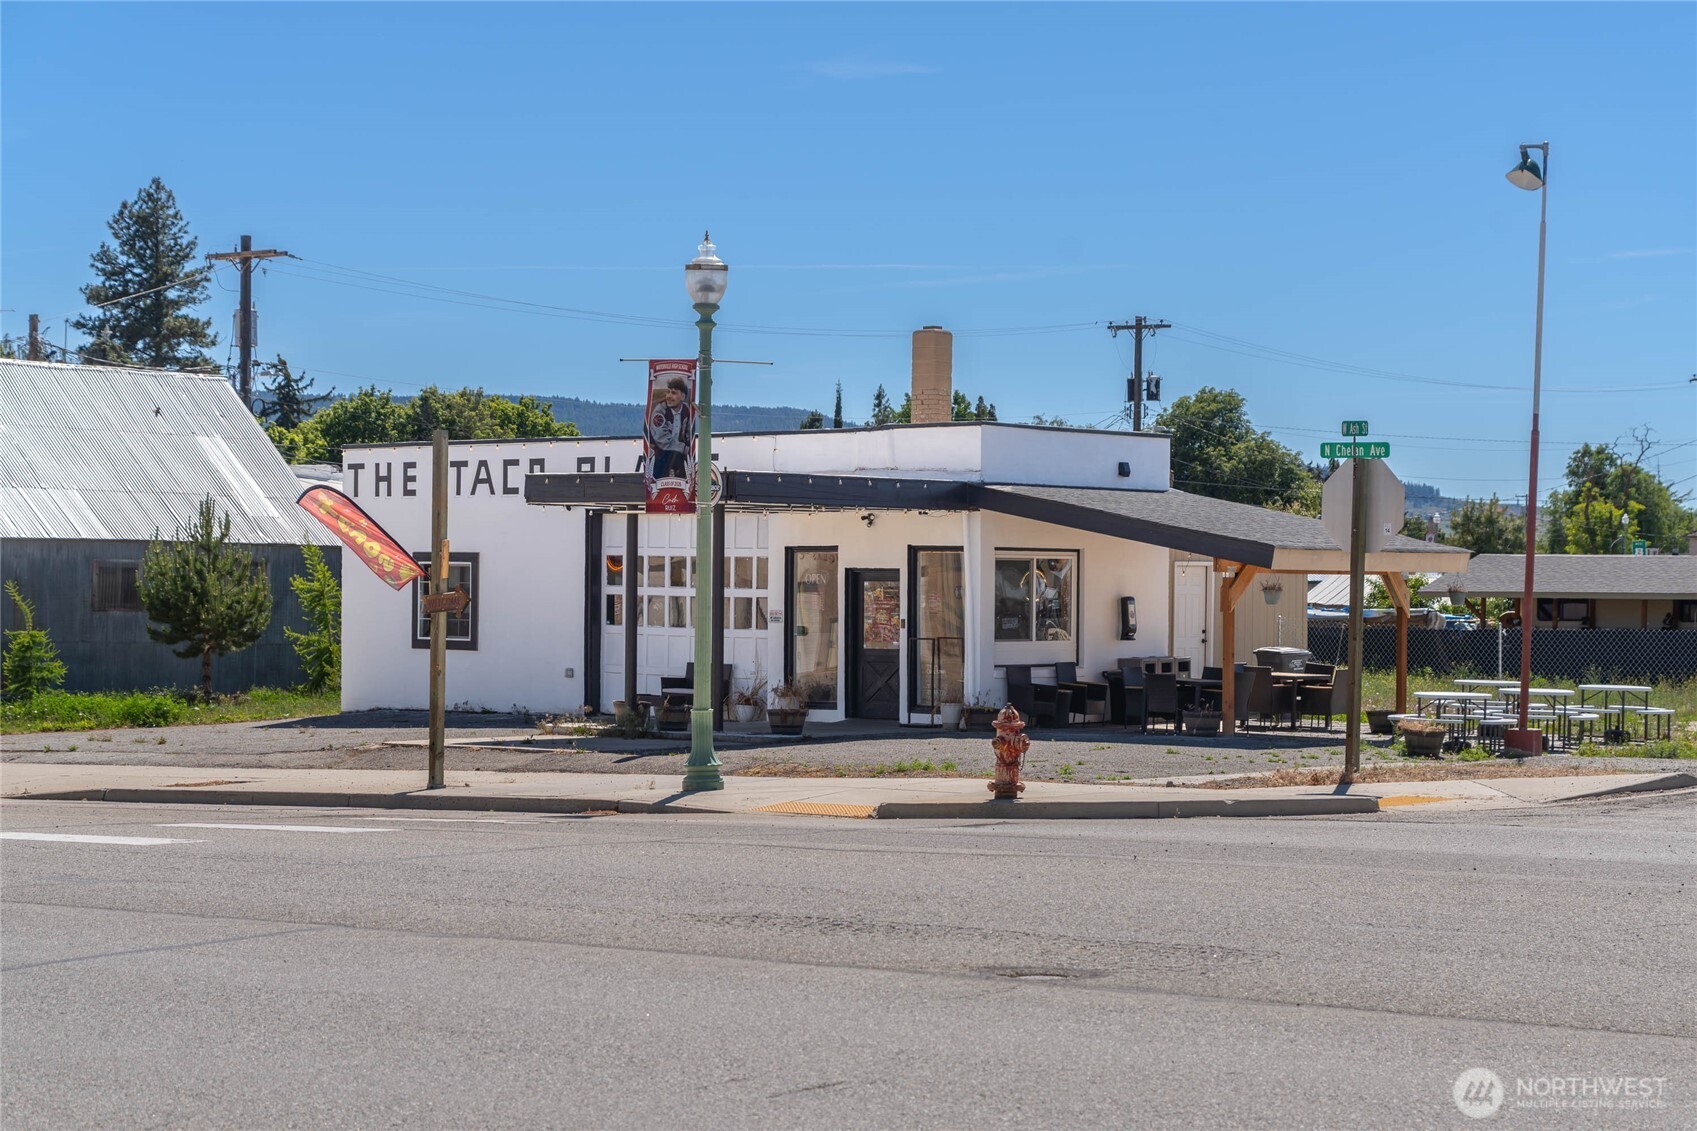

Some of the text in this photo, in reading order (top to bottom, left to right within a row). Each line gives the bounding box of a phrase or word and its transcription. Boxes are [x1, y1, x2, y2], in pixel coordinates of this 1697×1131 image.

[1349, 422, 1360, 434] Ash
[1361, 422, 1368, 434] St
[1324, 444, 1386, 457] N Chelan Ave
[347, 462, 417, 497] THE
[804, 573, 827, 585] OPEN
